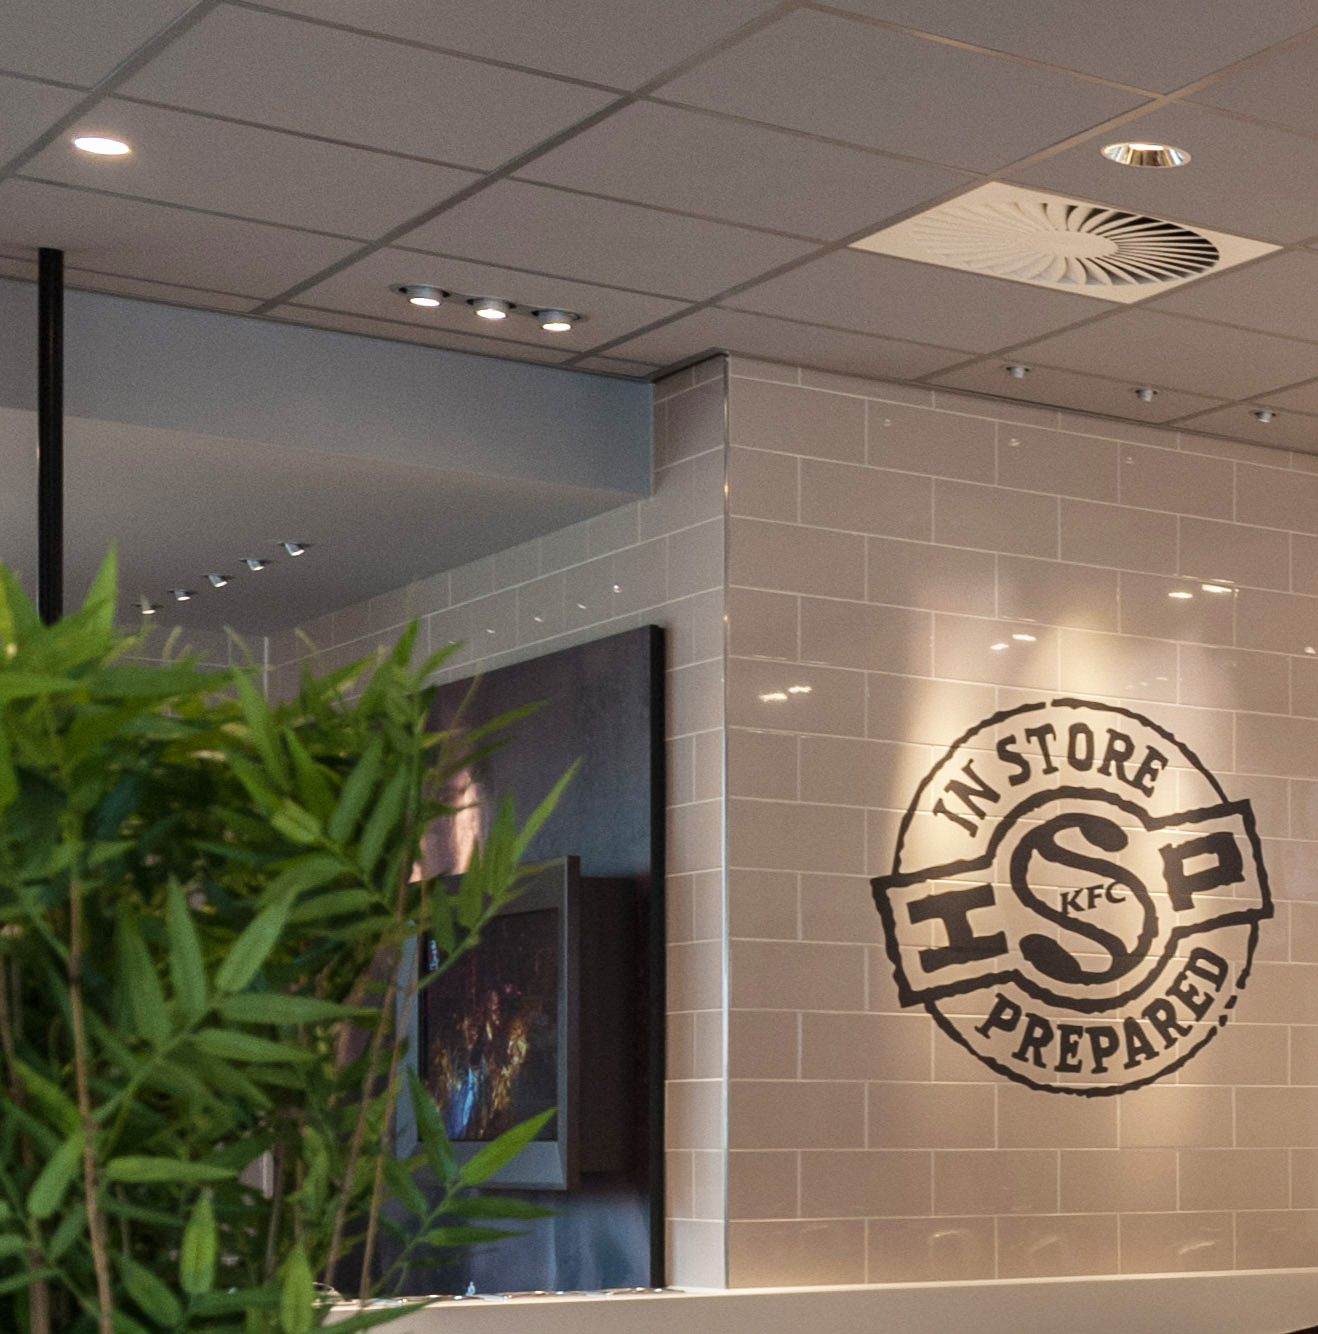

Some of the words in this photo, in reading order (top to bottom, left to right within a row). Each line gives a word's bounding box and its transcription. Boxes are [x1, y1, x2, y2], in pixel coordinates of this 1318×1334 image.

[932, 758, 1001, 838] IN
[995, 722, 1168, 798] STORE
[1060, 883, 1126, 917] KFC
[974, 946, 1230, 1075] PREPARED
